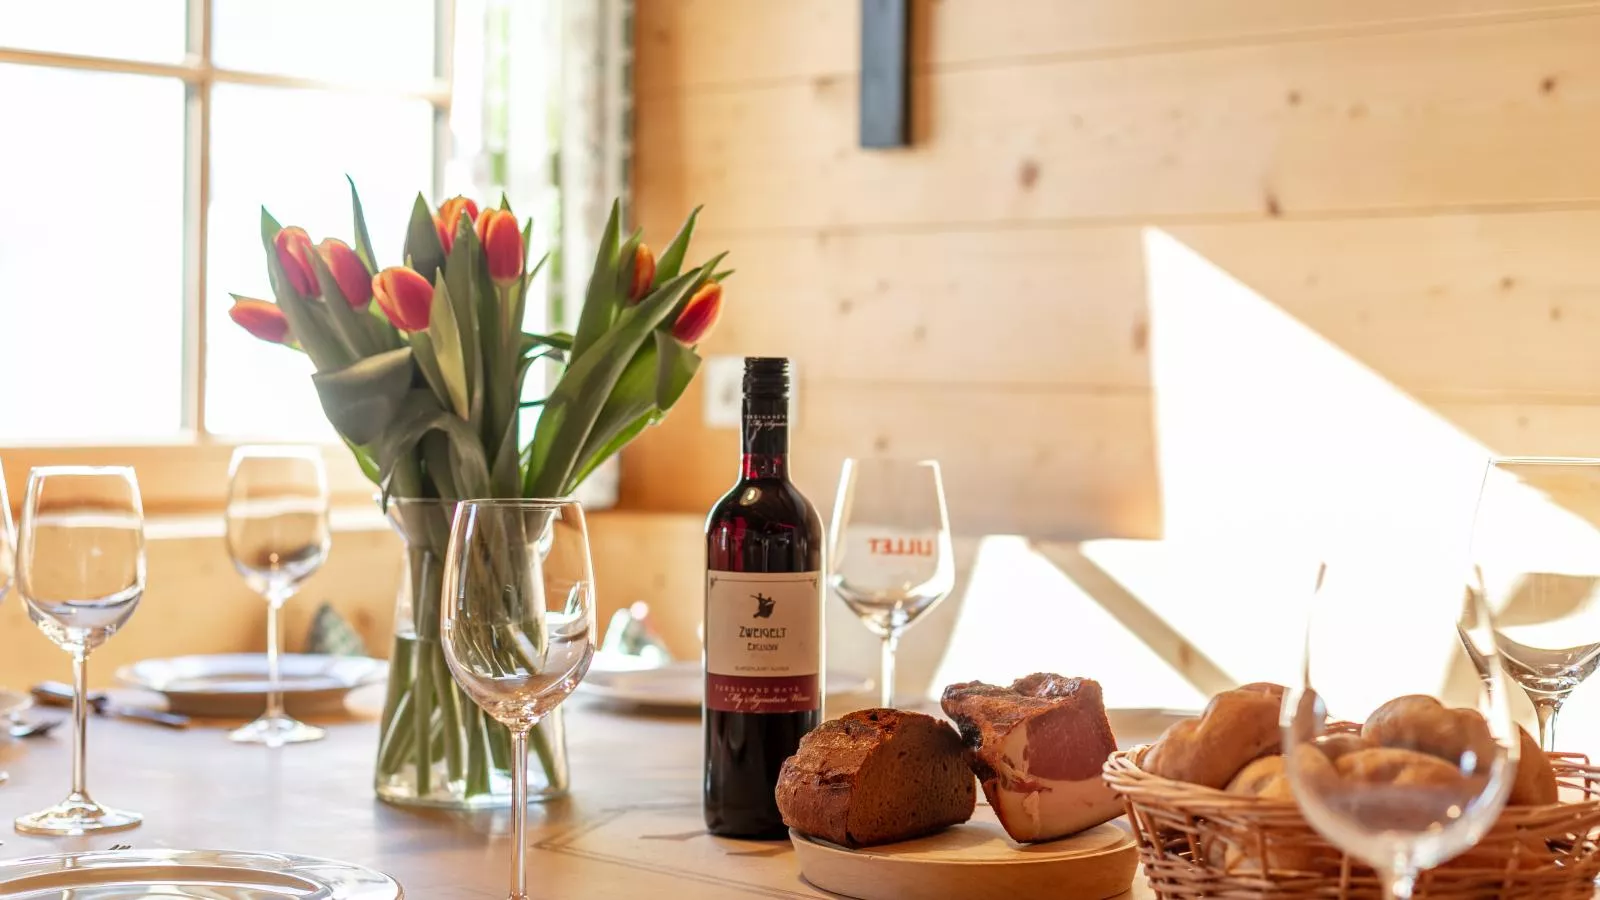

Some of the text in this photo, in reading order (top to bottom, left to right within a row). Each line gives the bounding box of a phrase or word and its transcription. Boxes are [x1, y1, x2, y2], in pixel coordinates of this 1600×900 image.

[738, 626, 787, 639] ZWEIGELT
[714, 683, 769, 694] FERDINAND
[724, 692, 743, 710] My
[744, 693, 788, 711] Signature
